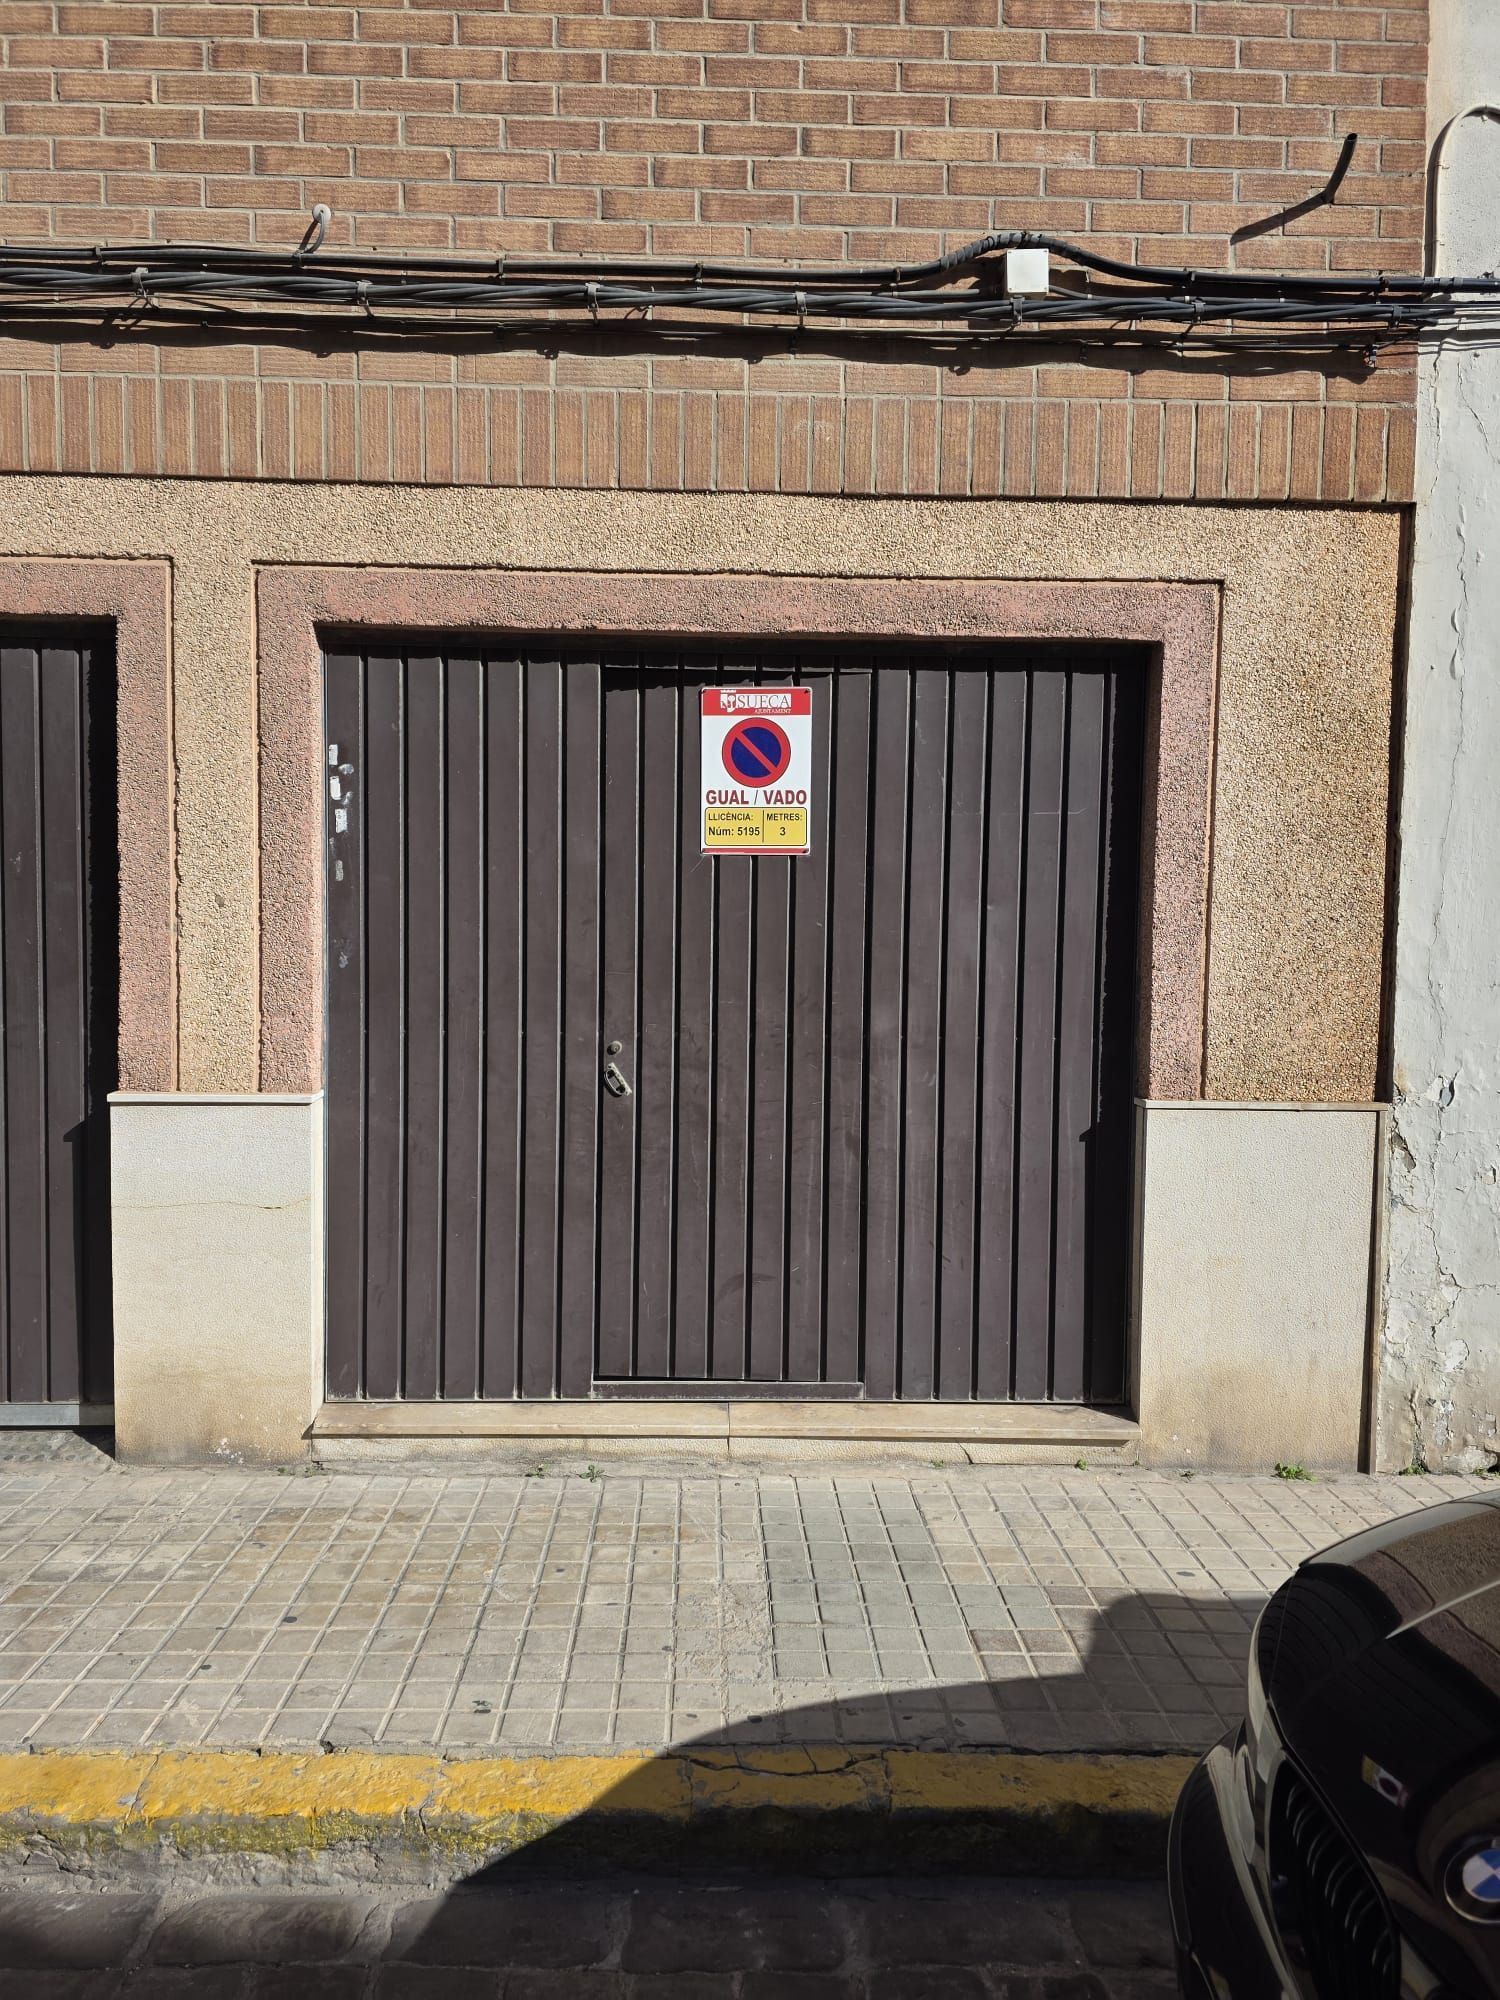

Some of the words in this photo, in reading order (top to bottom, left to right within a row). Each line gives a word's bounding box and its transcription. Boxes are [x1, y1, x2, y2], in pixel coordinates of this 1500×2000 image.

[737, 694, 790, 709] SUECA
[705, 789, 749, 805] GUAL
[753, 789, 759, 805] /
[763, 789, 807, 805] VADO
[766, 812, 803, 821] METRES:
[708, 826, 734, 836] Núm:
[737, 826, 760, 836] 5195
[779, 826, 786, 836] 3
